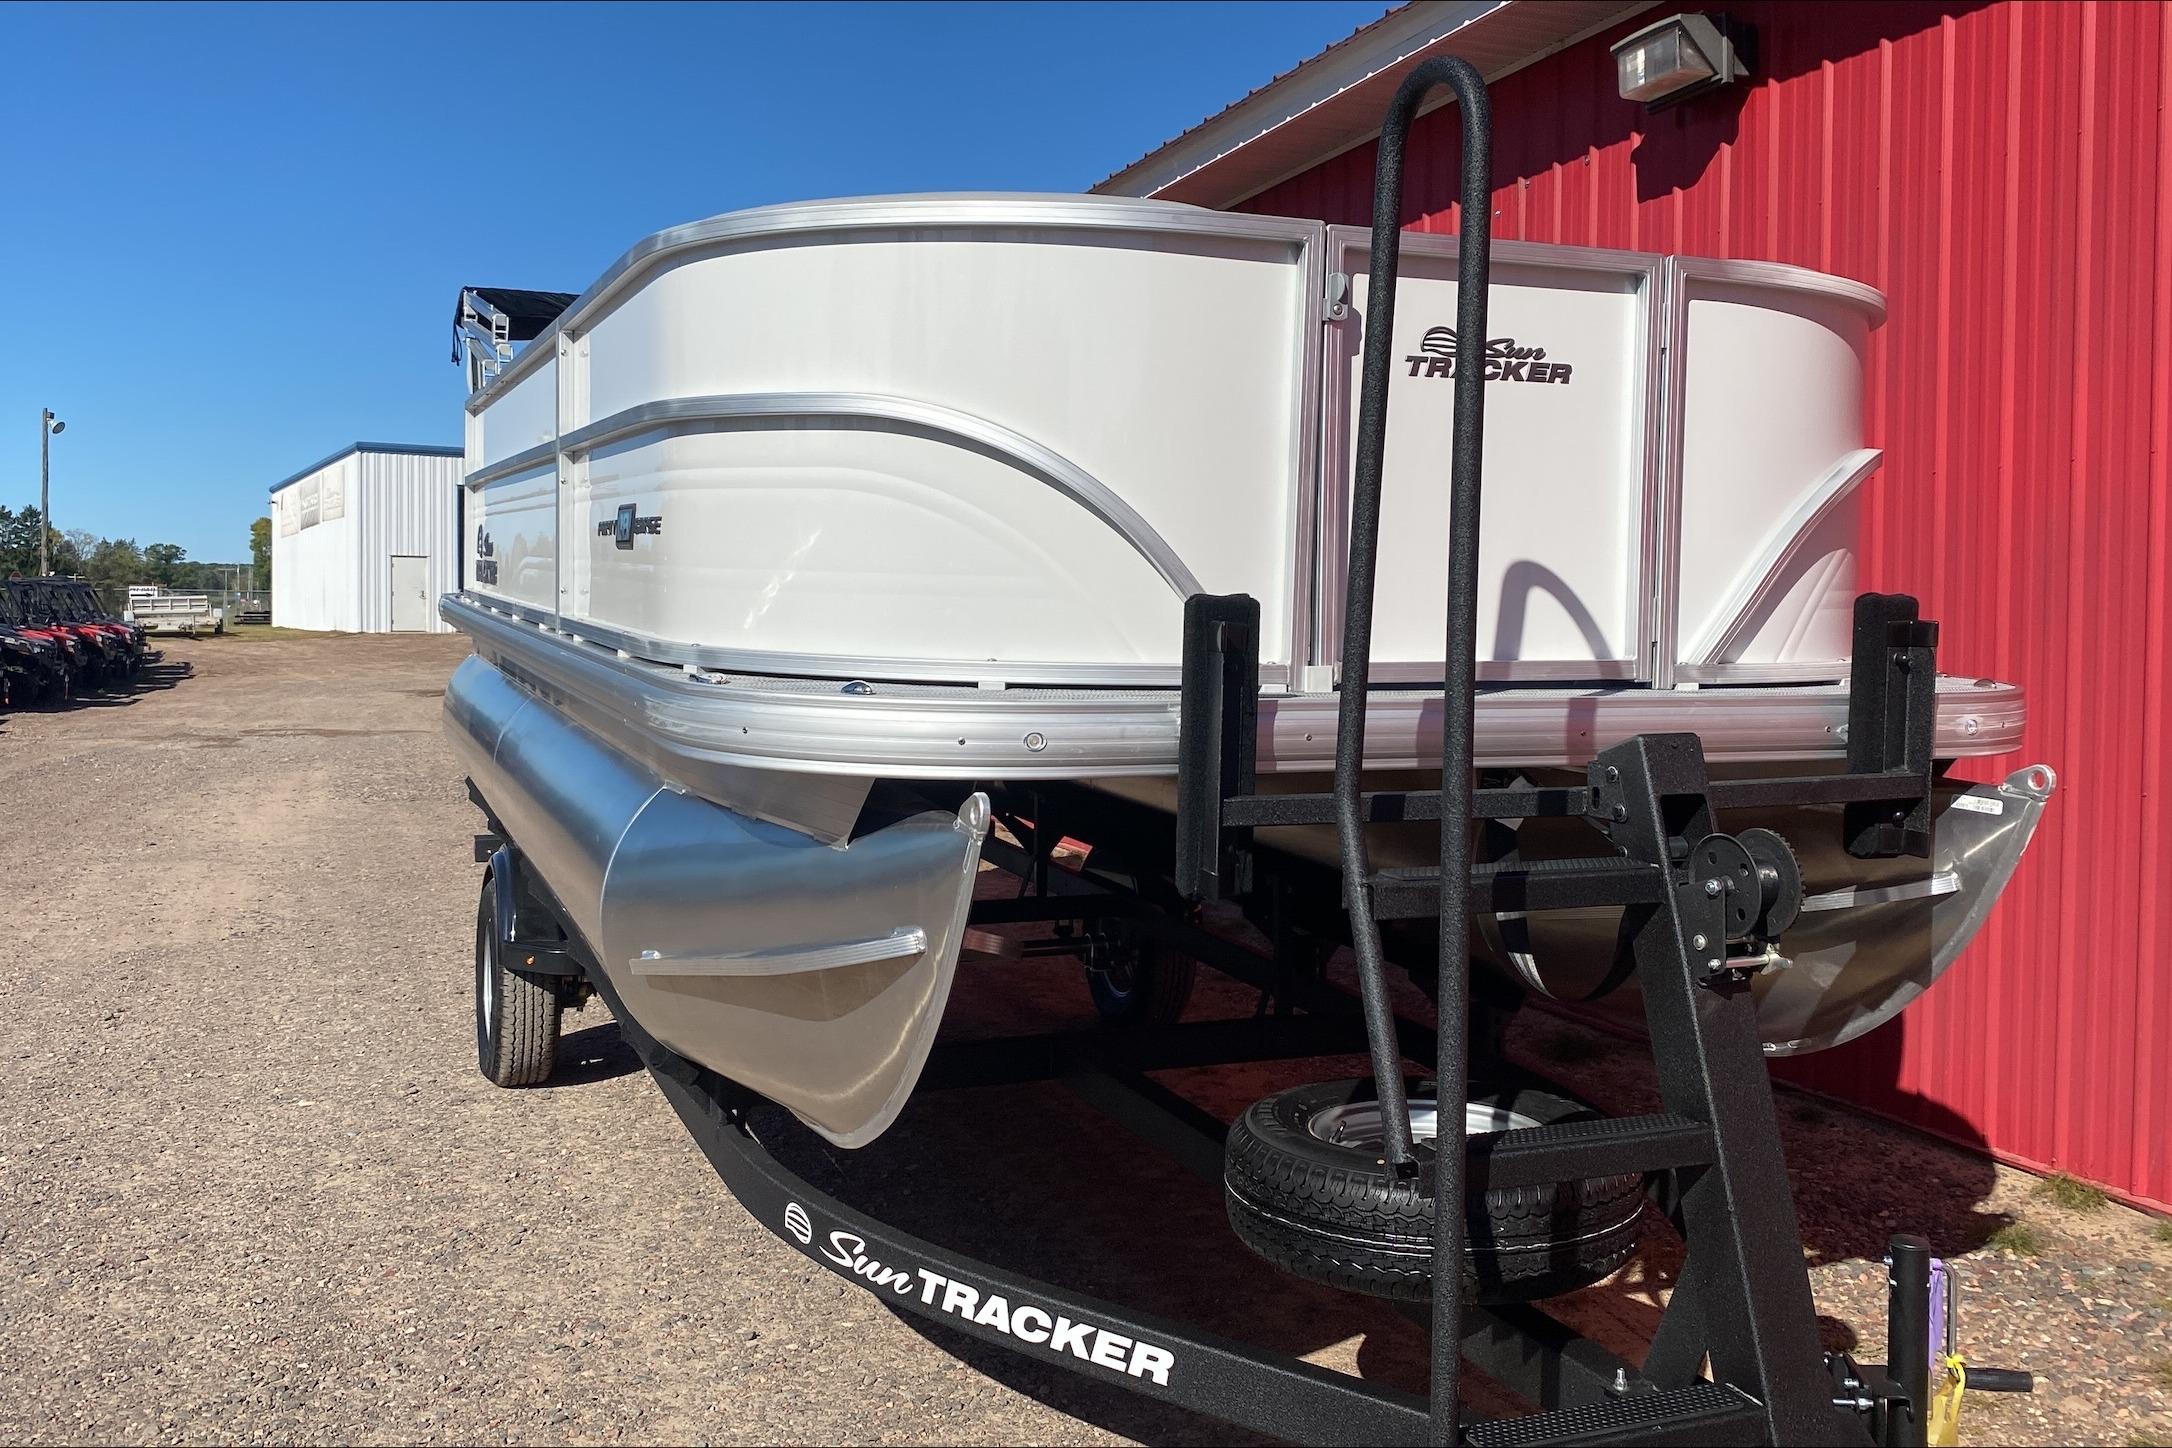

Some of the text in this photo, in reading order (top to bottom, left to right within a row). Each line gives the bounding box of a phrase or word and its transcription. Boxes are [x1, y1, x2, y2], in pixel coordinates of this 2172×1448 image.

[1485, 338, 1547, 361] Sun
[1405, 355, 1573, 385] TRCKER
[818, 1231, 1175, 1387] Sun TRACKER
